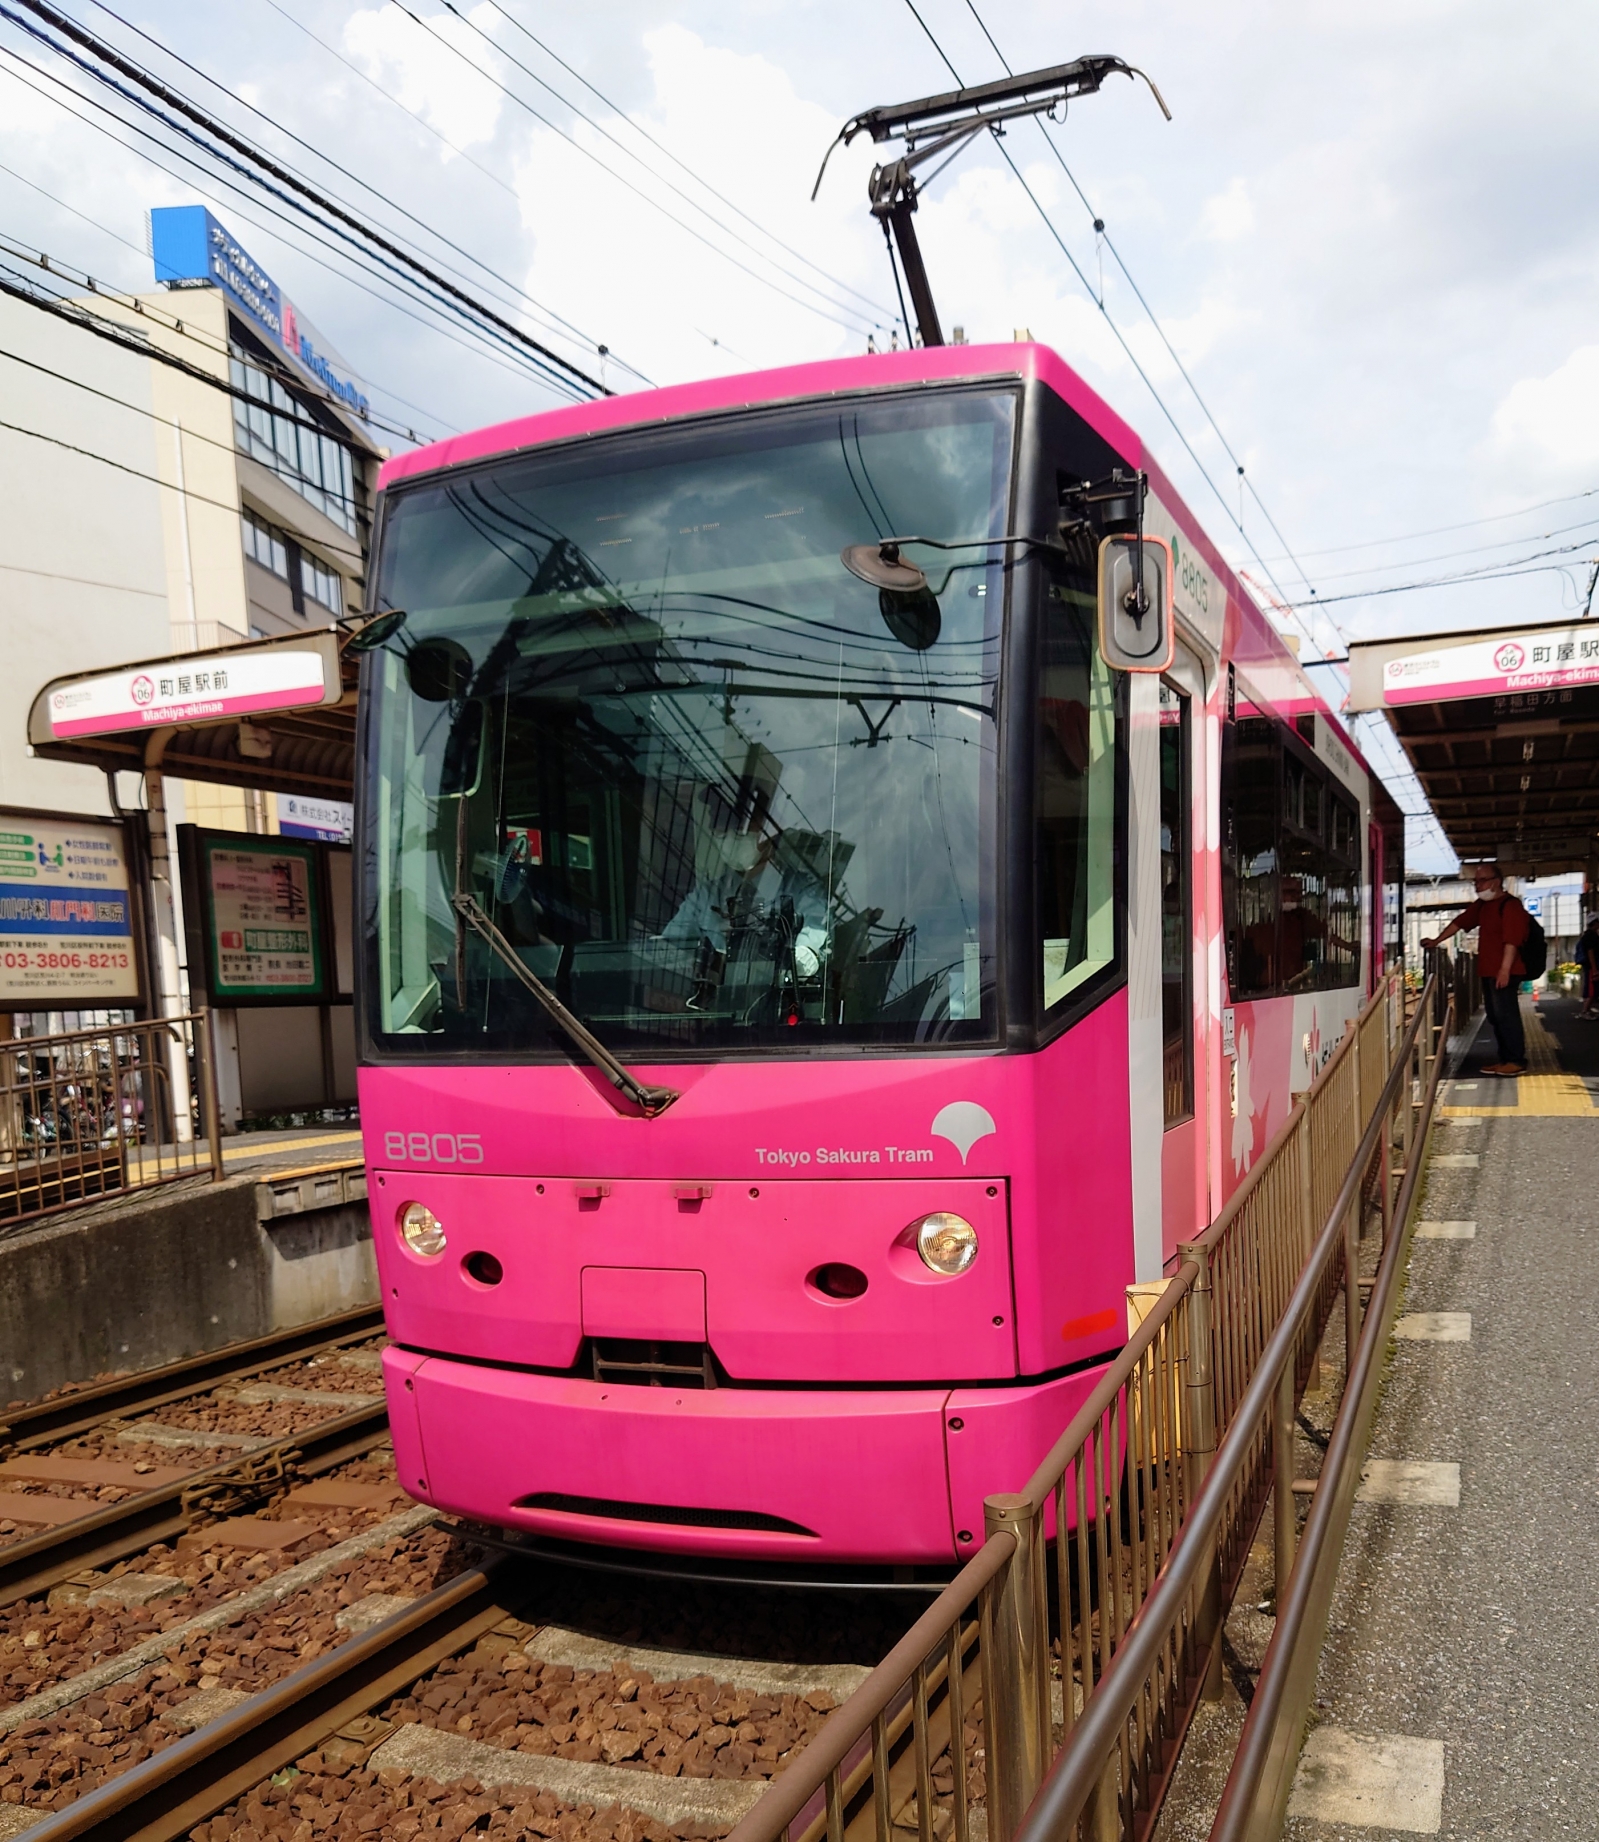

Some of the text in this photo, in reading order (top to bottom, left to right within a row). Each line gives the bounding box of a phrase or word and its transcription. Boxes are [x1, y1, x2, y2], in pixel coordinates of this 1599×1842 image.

[1182, 553, 1208, 613] 8805
[1501, 656, 1518, 667] 06
[1533, 640, 1599, 663] 町屋駅
[160, 670, 228, 697] 町屋駅前
[1506, 668, 1599, 688] Machiya-ekim
[137, 689, 150, 699] 06
[1494, 690, 1573, 708] 早稲田方面
[142, 701, 223, 722] Machiya-ekimae
[5, 952, 129, 969] 03-3806-8213
[384, 1131, 485, 1165] 8805
[755, 1146, 933, 1167] Tokyo Sakura Tram
